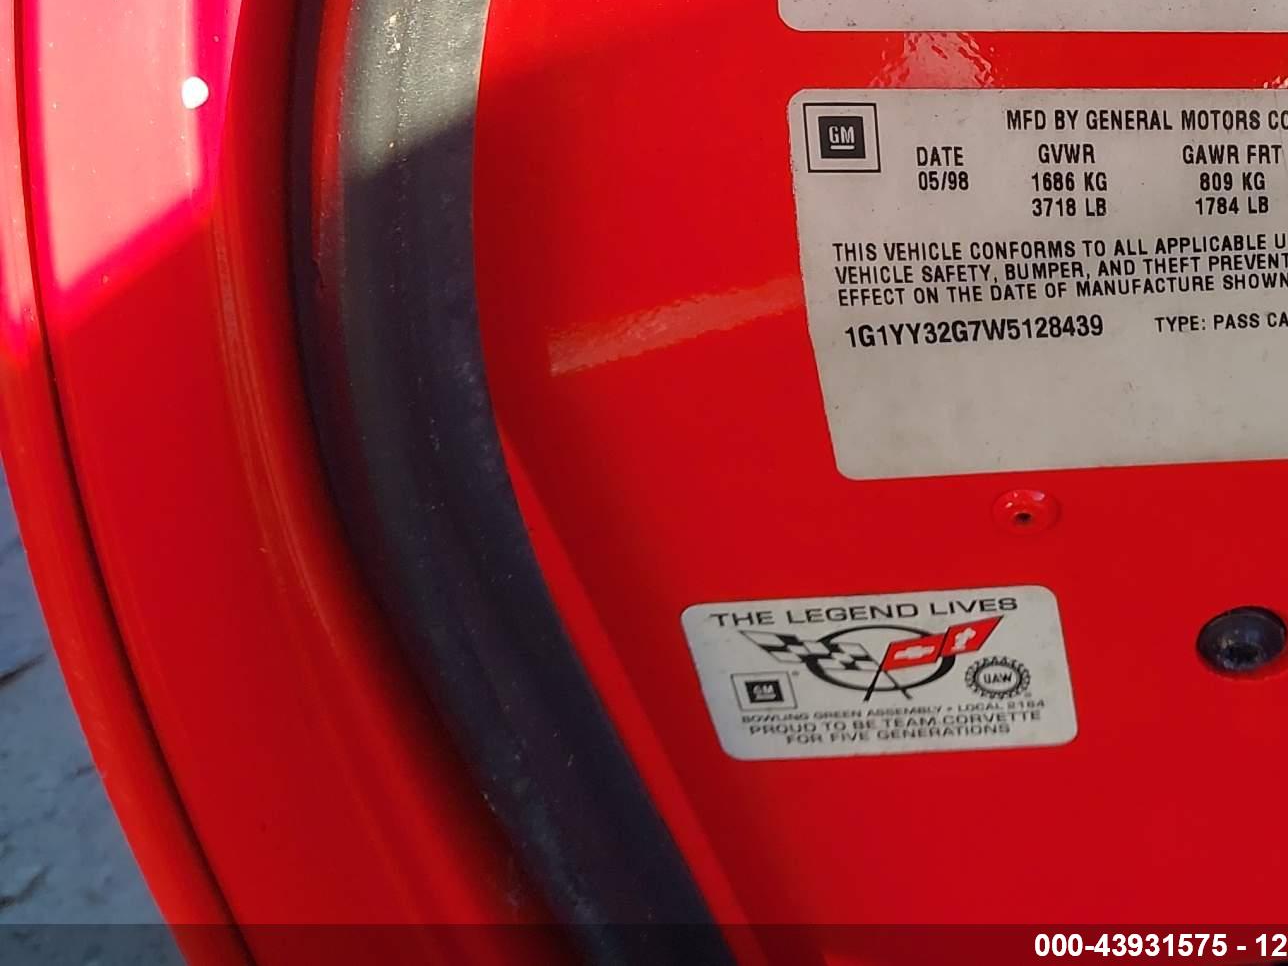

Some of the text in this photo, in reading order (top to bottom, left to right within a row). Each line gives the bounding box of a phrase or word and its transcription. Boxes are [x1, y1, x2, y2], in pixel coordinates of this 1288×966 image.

[1007, 110, 1046, 131] MFD
[1055, 110, 1078, 131] BY
[1086, 109, 1172, 131] GENERAL
[1181, 110, 1260, 131] MOTORS
[829, 125, 855, 144] GM
[916, 146, 964, 167] DATE
[1038, 144, 1095, 164] GVWR
[1182, 144, 1240, 165] GAWR
[1247, 144, 1282, 164] FRT
[918, 171, 969, 191] 05/98
[1031, 172, 1075, 192] 1686
[1084, 172, 1108, 192] KG
[1199, 172, 1234, 192] 809
[1242, 172, 1266, 191] KG
[1032, 197, 1076, 217] 3718
[1085, 197, 1107, 217] LB
[1195, 196, 1240, 215] 1784
[1248, 195, 1269, 214] LB
[833, 242, 877, 263] THIS
[884, 241, 962, 262] VEHICLE
[970, 240, 1075, 260] CONFORMS
[1083, 239, 1106, 258] TO
[1114, 238, 1148, 256] ALL
[1155, 233, 1266, 255] APPLICABLE
[835, 264, 914, 285] VEHICLE
[921, 263, 998, 284] SAFETY,
[1005, 260, 1091, 282] BUMPER,
[1098, 259, 1136, 278] AND
[1143, 256, 1201, 276] THEFT
[839, 287, 905, 307] EFFECT
[914, 286, 939, 304] ON
[946, 285, 983, 303] THE
[991, 283, 1037, 302] DATE
[1045, 281, 1068, 299] OF
[1076, 274, 1215, 298] MANUFACTURE
[845, 314, 1104, 349] 1G1YY32G7W5128439
[1155, 315, 1206, 333] TYPE:
[1214, 313, 1260, 330] PASS
[710, 597, 1019, 628] THE LEGEND LIVES
[749, 710, 1041, 735] PROUD TO BE TEAM CORVETTE
[786, 723, 1010, 744] FOR FIVE GENERATIONS
